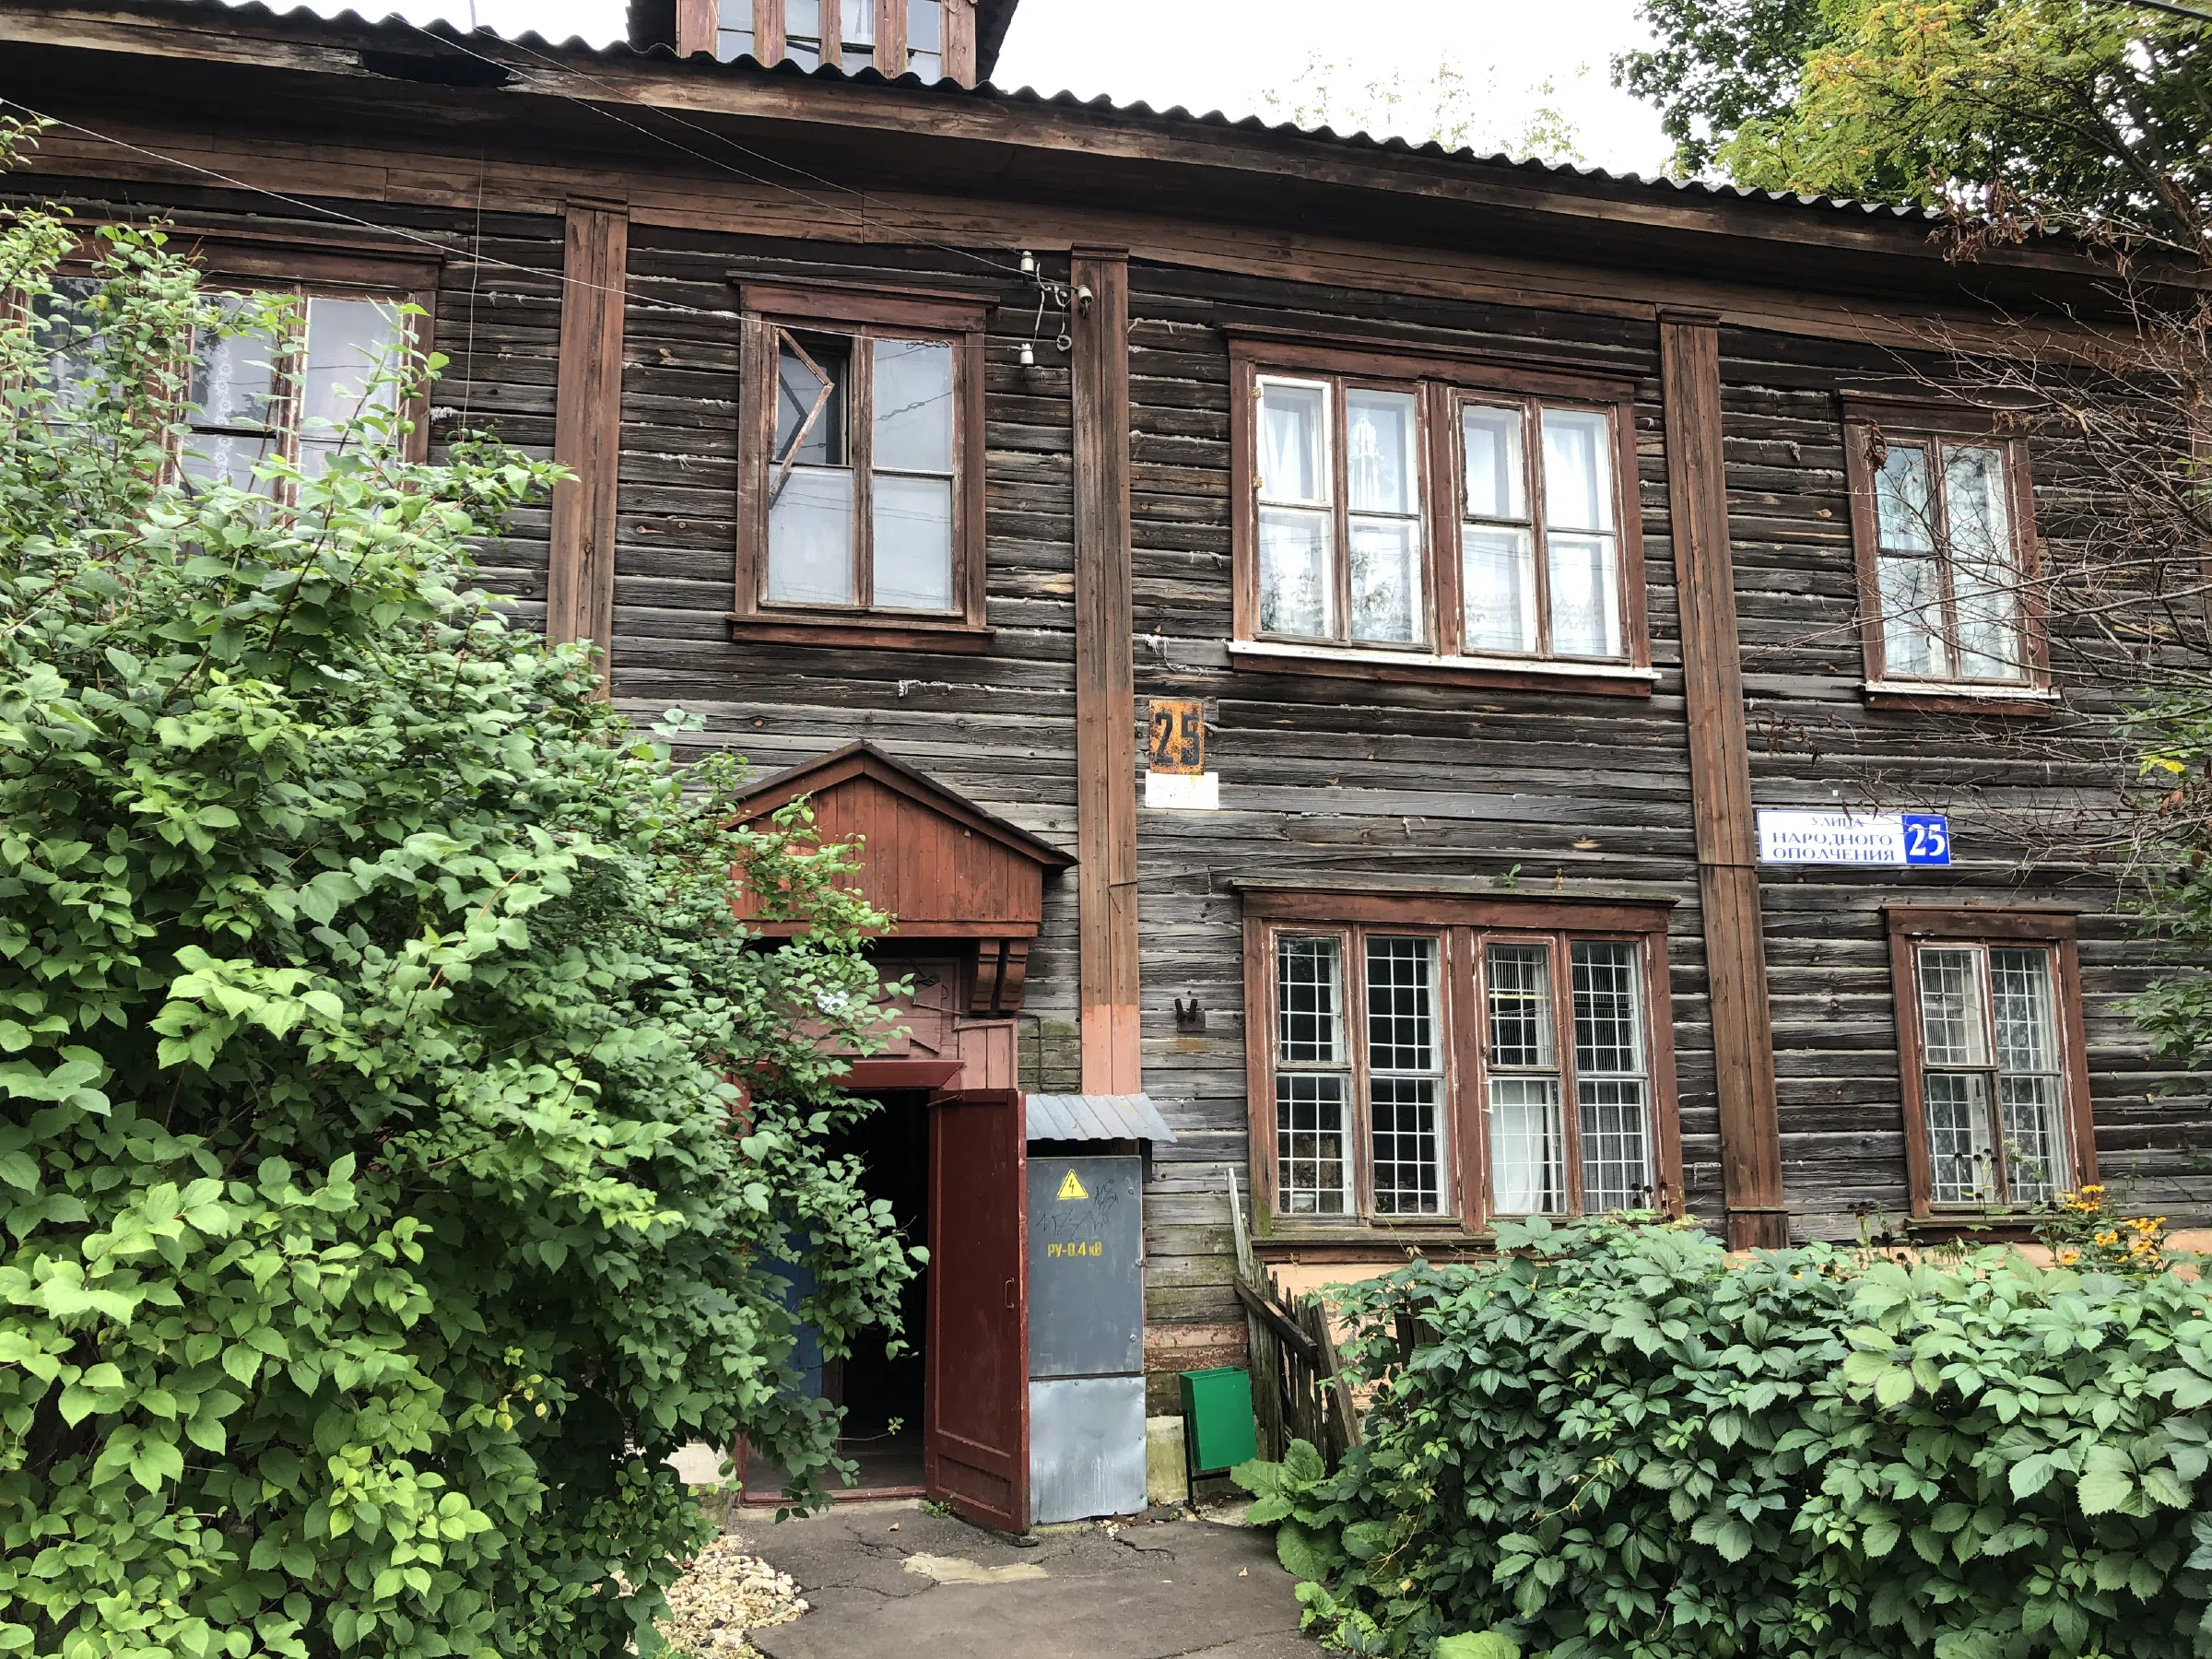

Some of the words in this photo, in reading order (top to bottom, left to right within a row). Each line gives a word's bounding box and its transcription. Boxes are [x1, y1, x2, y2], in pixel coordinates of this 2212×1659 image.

[1155, 712, 1200, 766] 25
[1811, 817, 1864, 830] УЛИЦА
[1772, 832, 1892, 847] НАРОДНОГО
[1908, 823, 1946, 856] 25
[1772, 847, 1895, 861] ОПОЛЧЕНИЯ
